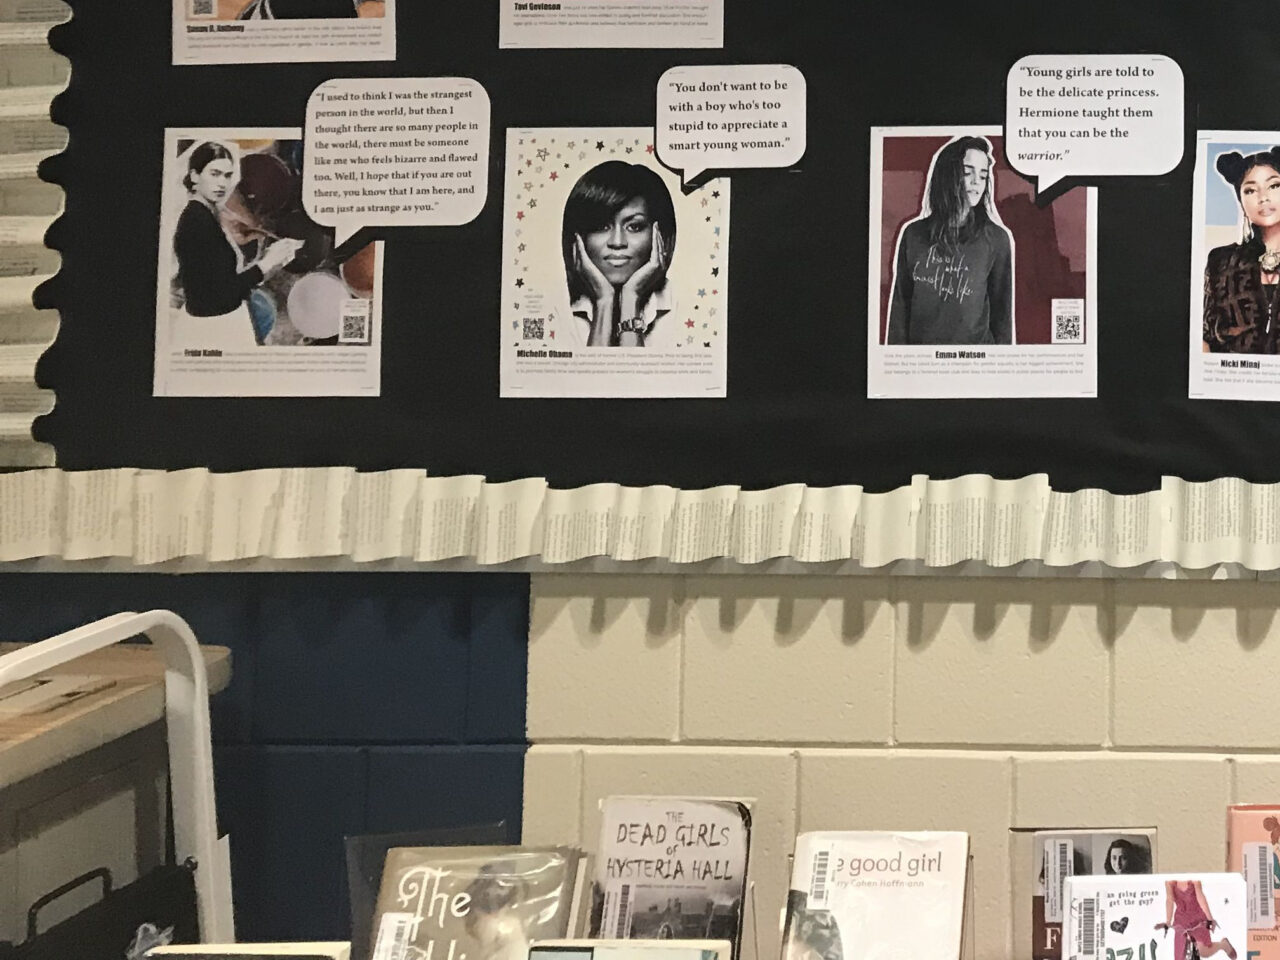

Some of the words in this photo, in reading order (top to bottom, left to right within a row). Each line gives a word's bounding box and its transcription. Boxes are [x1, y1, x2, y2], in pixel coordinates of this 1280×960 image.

[1019, 86, 1033, 97] be
[1036, 86, 1055, 97] the
[1058, 86, 1103, 97] delicate
[1106, 87, 1158, 100] princess.
[1019, 107, 1078, 117] Hermione
[1082, 106, 1119, 120] taught
[1123, 106, 1152, 117] them
[668, 120, 703, 133] stupid
[706, 121, 718, 130] to
[721, 119, 778, 132] appreciate
[668, 141, 700, 150] smart
[703, 141, 738, 152] young
[517, 350, 547, 358] Michelle
[549, 350, 572, 358] Obama
[936, 351, 957, 359] Emma
[958, 351, 986, 359] Watson
[1220, 360, 1239, 368] Nicki
[1240, 360, 1260, 369] Minaj
[666, 812, 684, 823] THE
[616, 823, 667, 847] DEAD
[675, 823, 730, 847] GIRLS
[606, 857, 684, 880] HYSTERIA
[692, 859, 733, 880] HALL
[849, 851, 902, 876] good
[907, 851, 942, 876] girl
[397, 865, 472, 941] The
